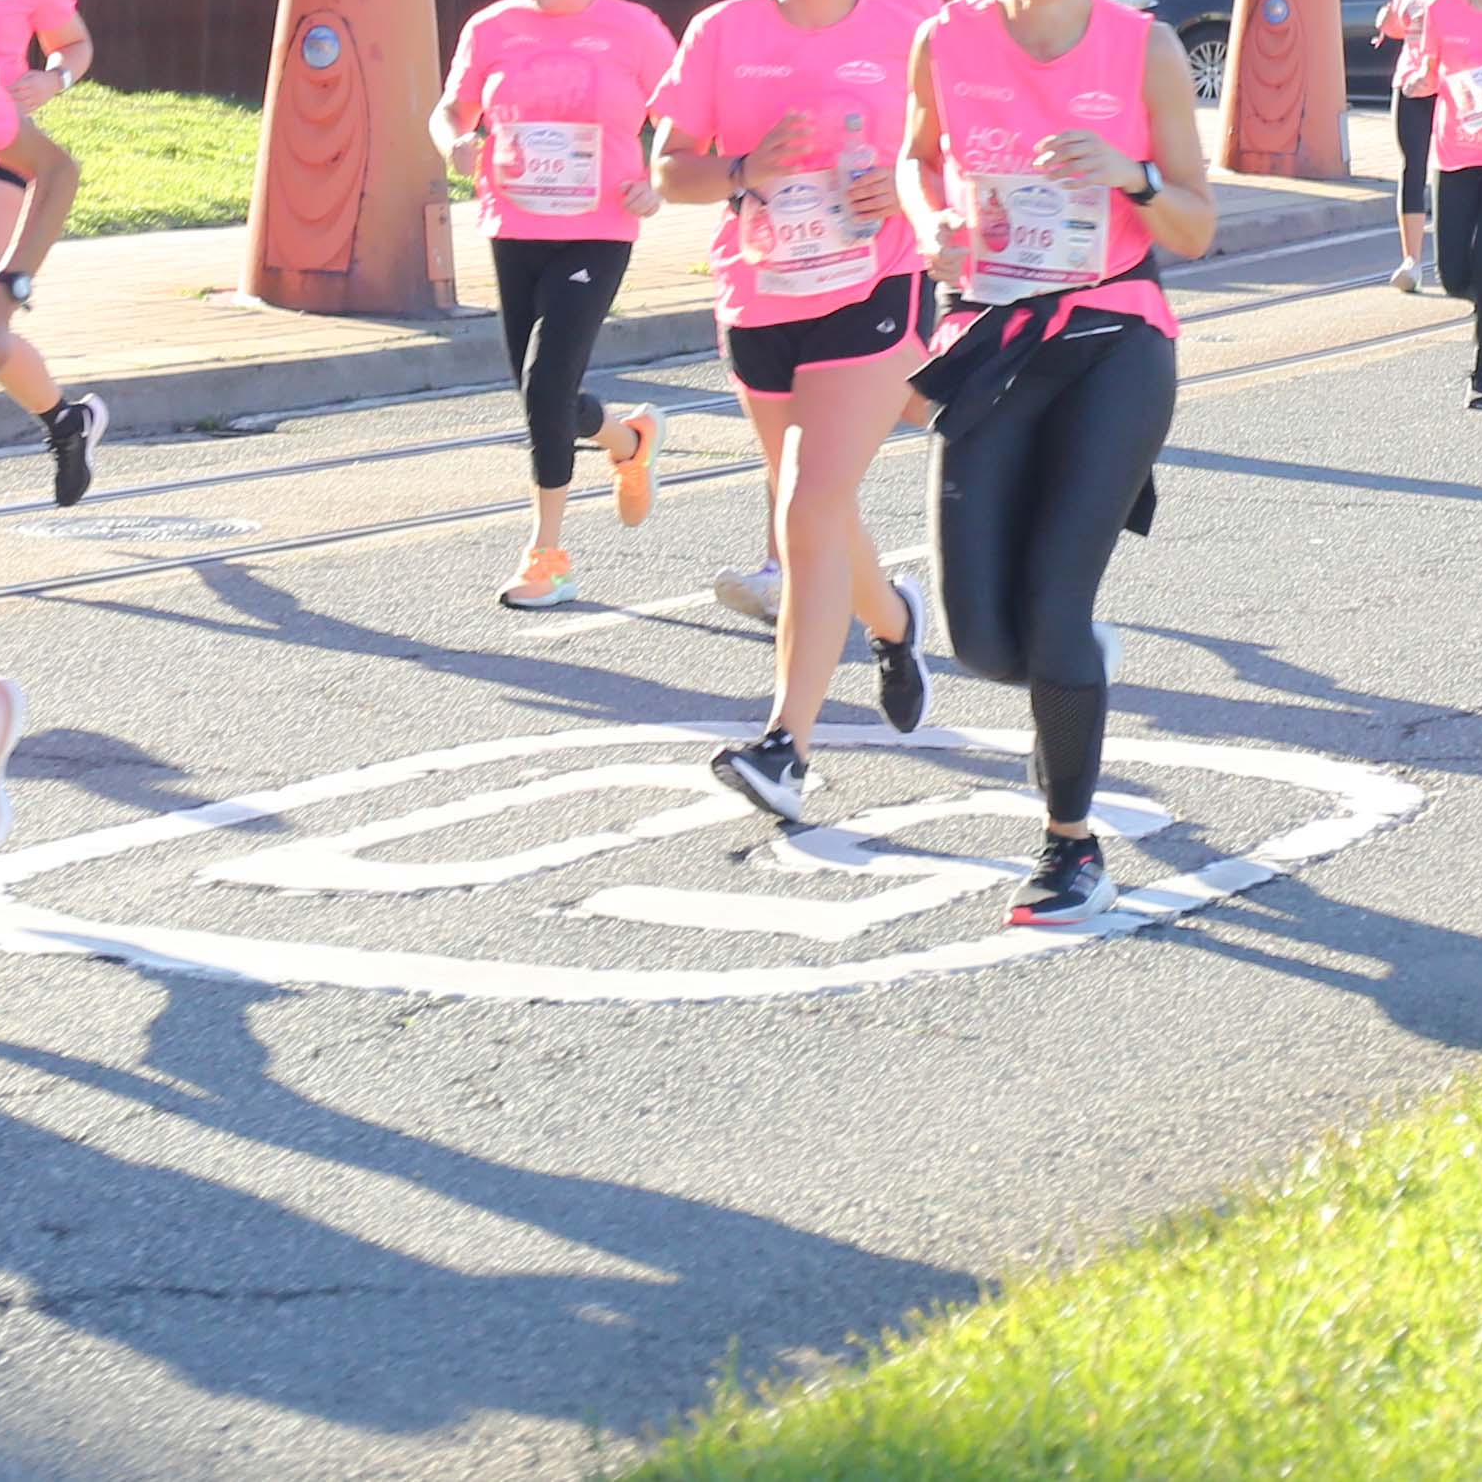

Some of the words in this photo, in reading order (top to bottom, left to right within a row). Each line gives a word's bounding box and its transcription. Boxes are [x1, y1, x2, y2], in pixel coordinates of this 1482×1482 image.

[528, 158, 566, 174] 016
[778, 219, 825, 242] 016
[1013, 225, 1055, 248] 016
